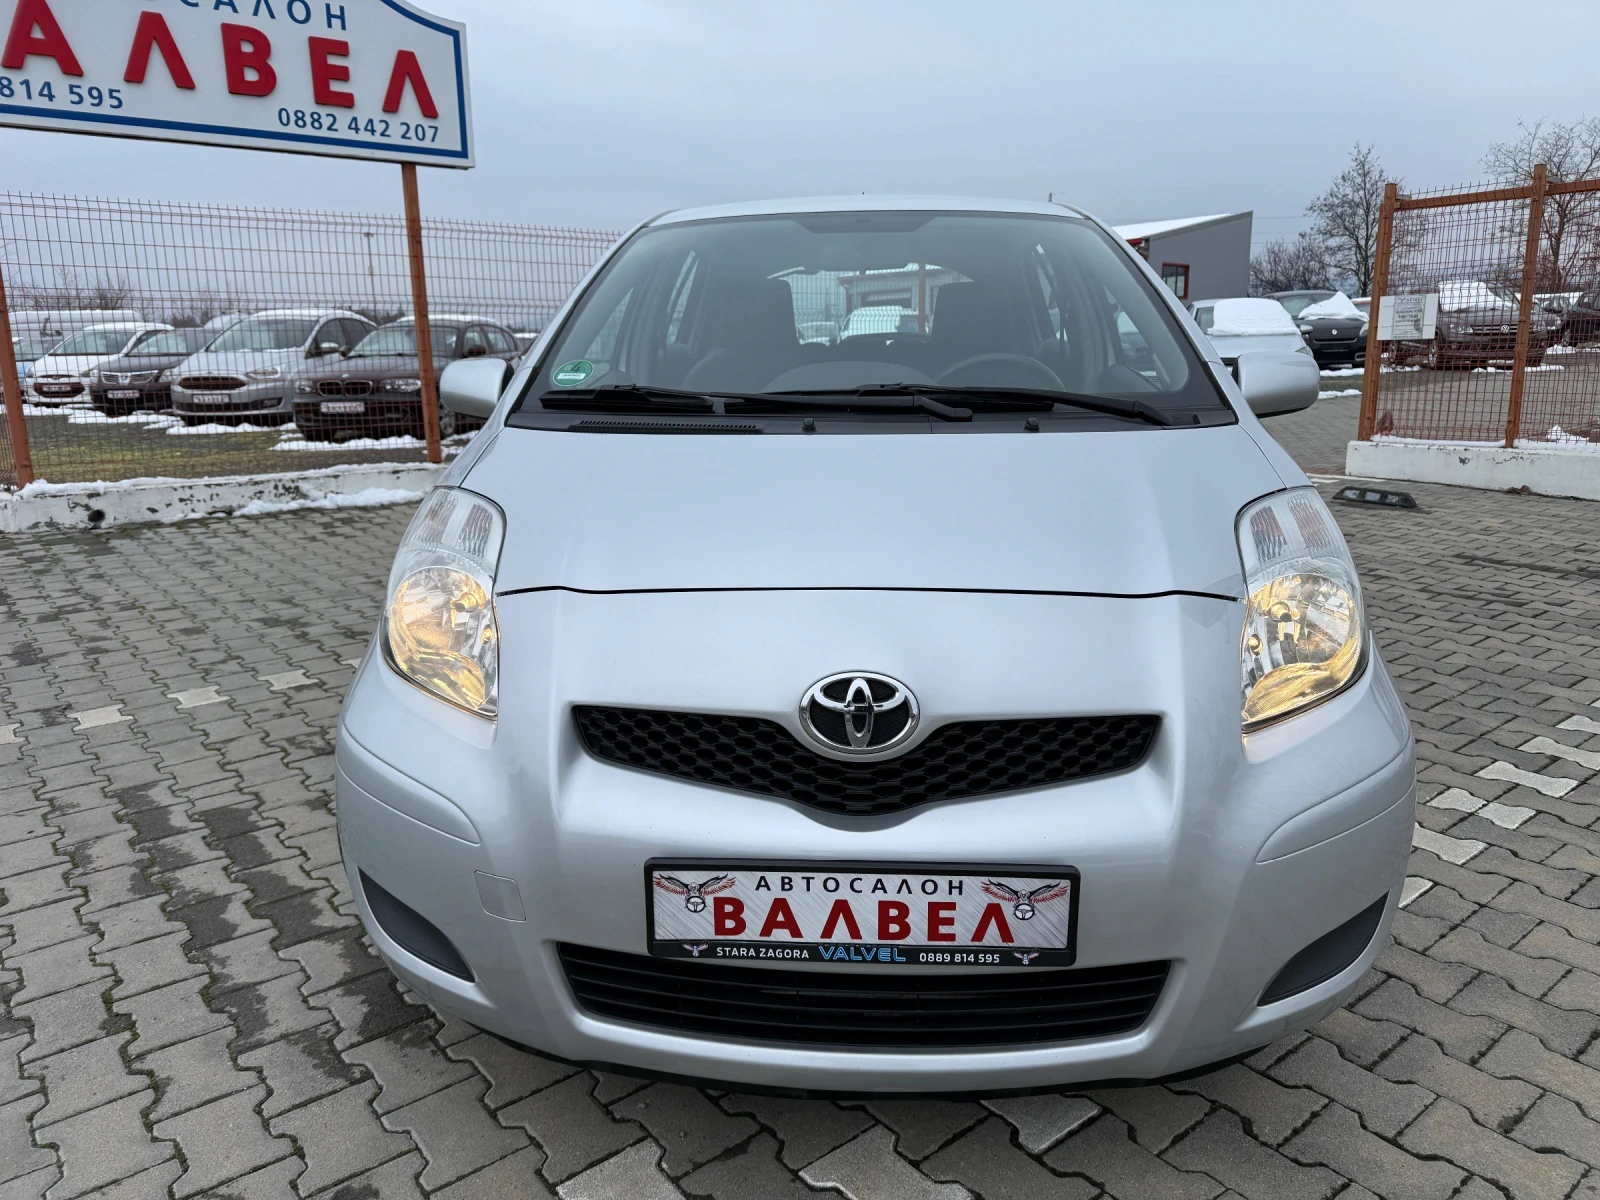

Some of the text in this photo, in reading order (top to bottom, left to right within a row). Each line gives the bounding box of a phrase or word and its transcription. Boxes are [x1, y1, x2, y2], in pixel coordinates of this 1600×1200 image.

[179, 0, 347, 31] АЛОН
[0, 75, 124, 109] 814 595
[278, 107, 439, 143] 0882 442 207
[569, 361, 582, 373] 4
[754, 875, 964, 896] АВТОСАЛОН
[712, 896, 1015, 944] ВАЛВЕЛ
[716, 946, 1000, 964] STARA ZAGORA VALVEL 0889 814 595
